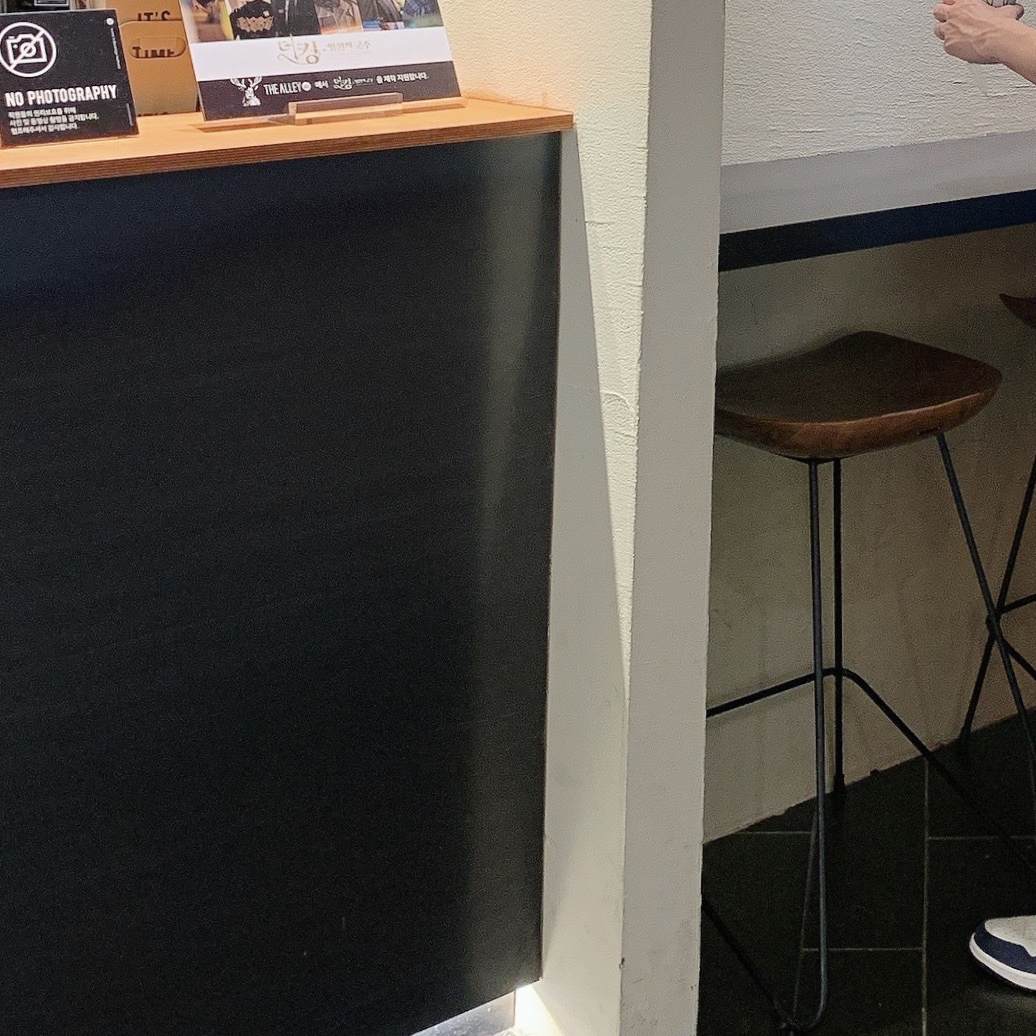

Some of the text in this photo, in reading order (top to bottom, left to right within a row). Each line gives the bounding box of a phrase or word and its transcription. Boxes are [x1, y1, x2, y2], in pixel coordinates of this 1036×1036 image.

[5, 84, 118, 107] NO PHOTOGRAPHY
[264, 84, 280, 96] THE
[280, 81, 302, 95] ALLEY
